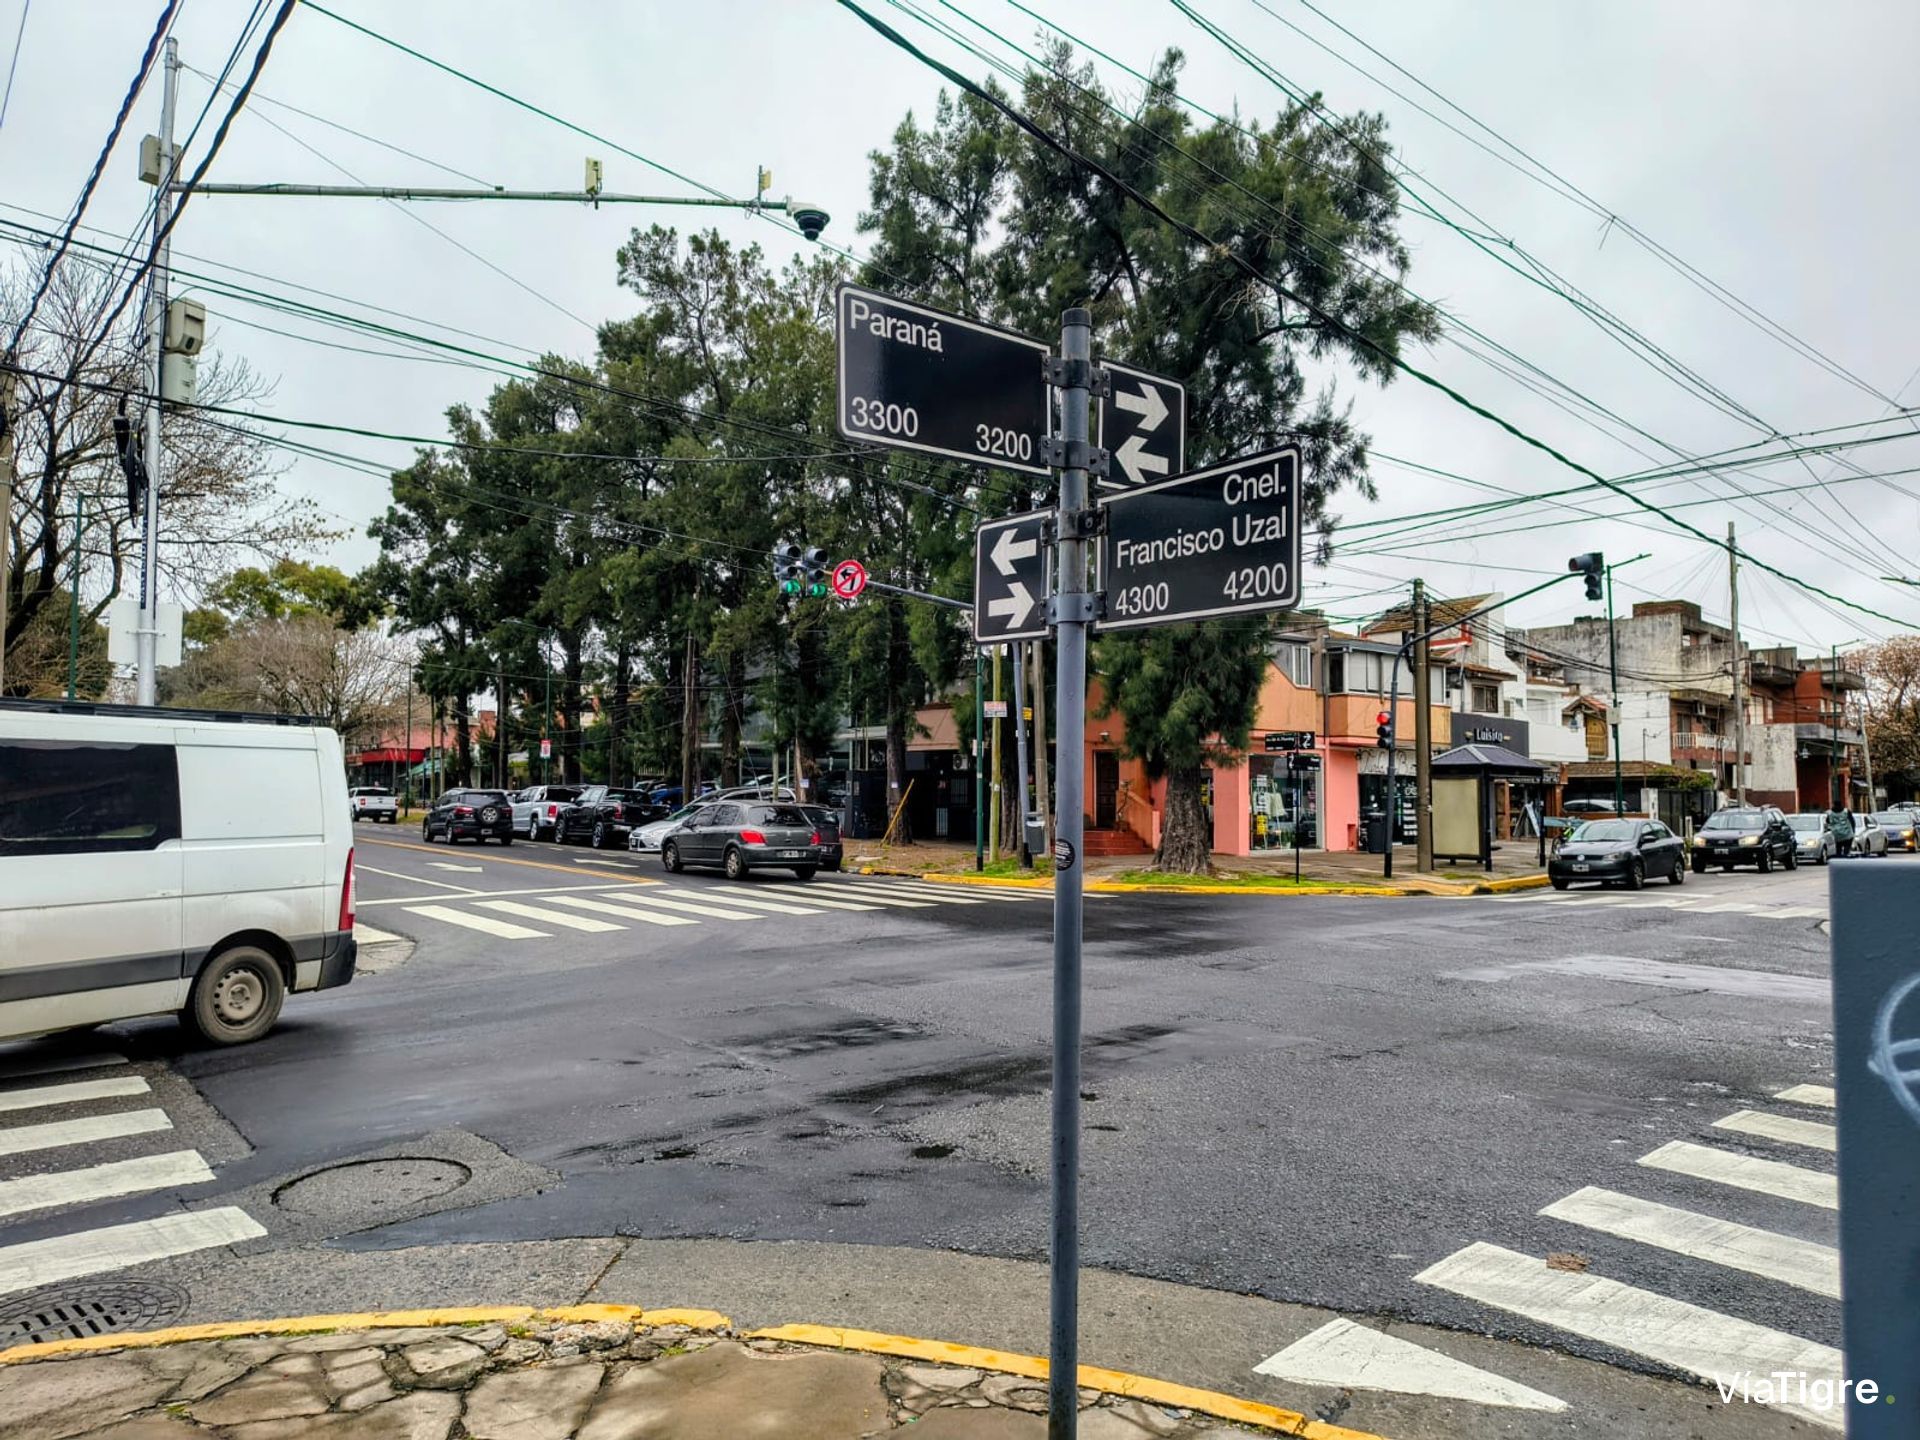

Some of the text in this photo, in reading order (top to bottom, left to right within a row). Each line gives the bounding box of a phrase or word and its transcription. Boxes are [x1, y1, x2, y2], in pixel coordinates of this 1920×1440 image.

[850, 299, 943, 353] Paraná
[851, 396, 1032, 461] 3300 3200
[1223, 463, 1287, 505] Cnel.
[1116, 505, 1287, 568] Francisco Uzal
[1115, 562, 1288, 616] 4300 4200
